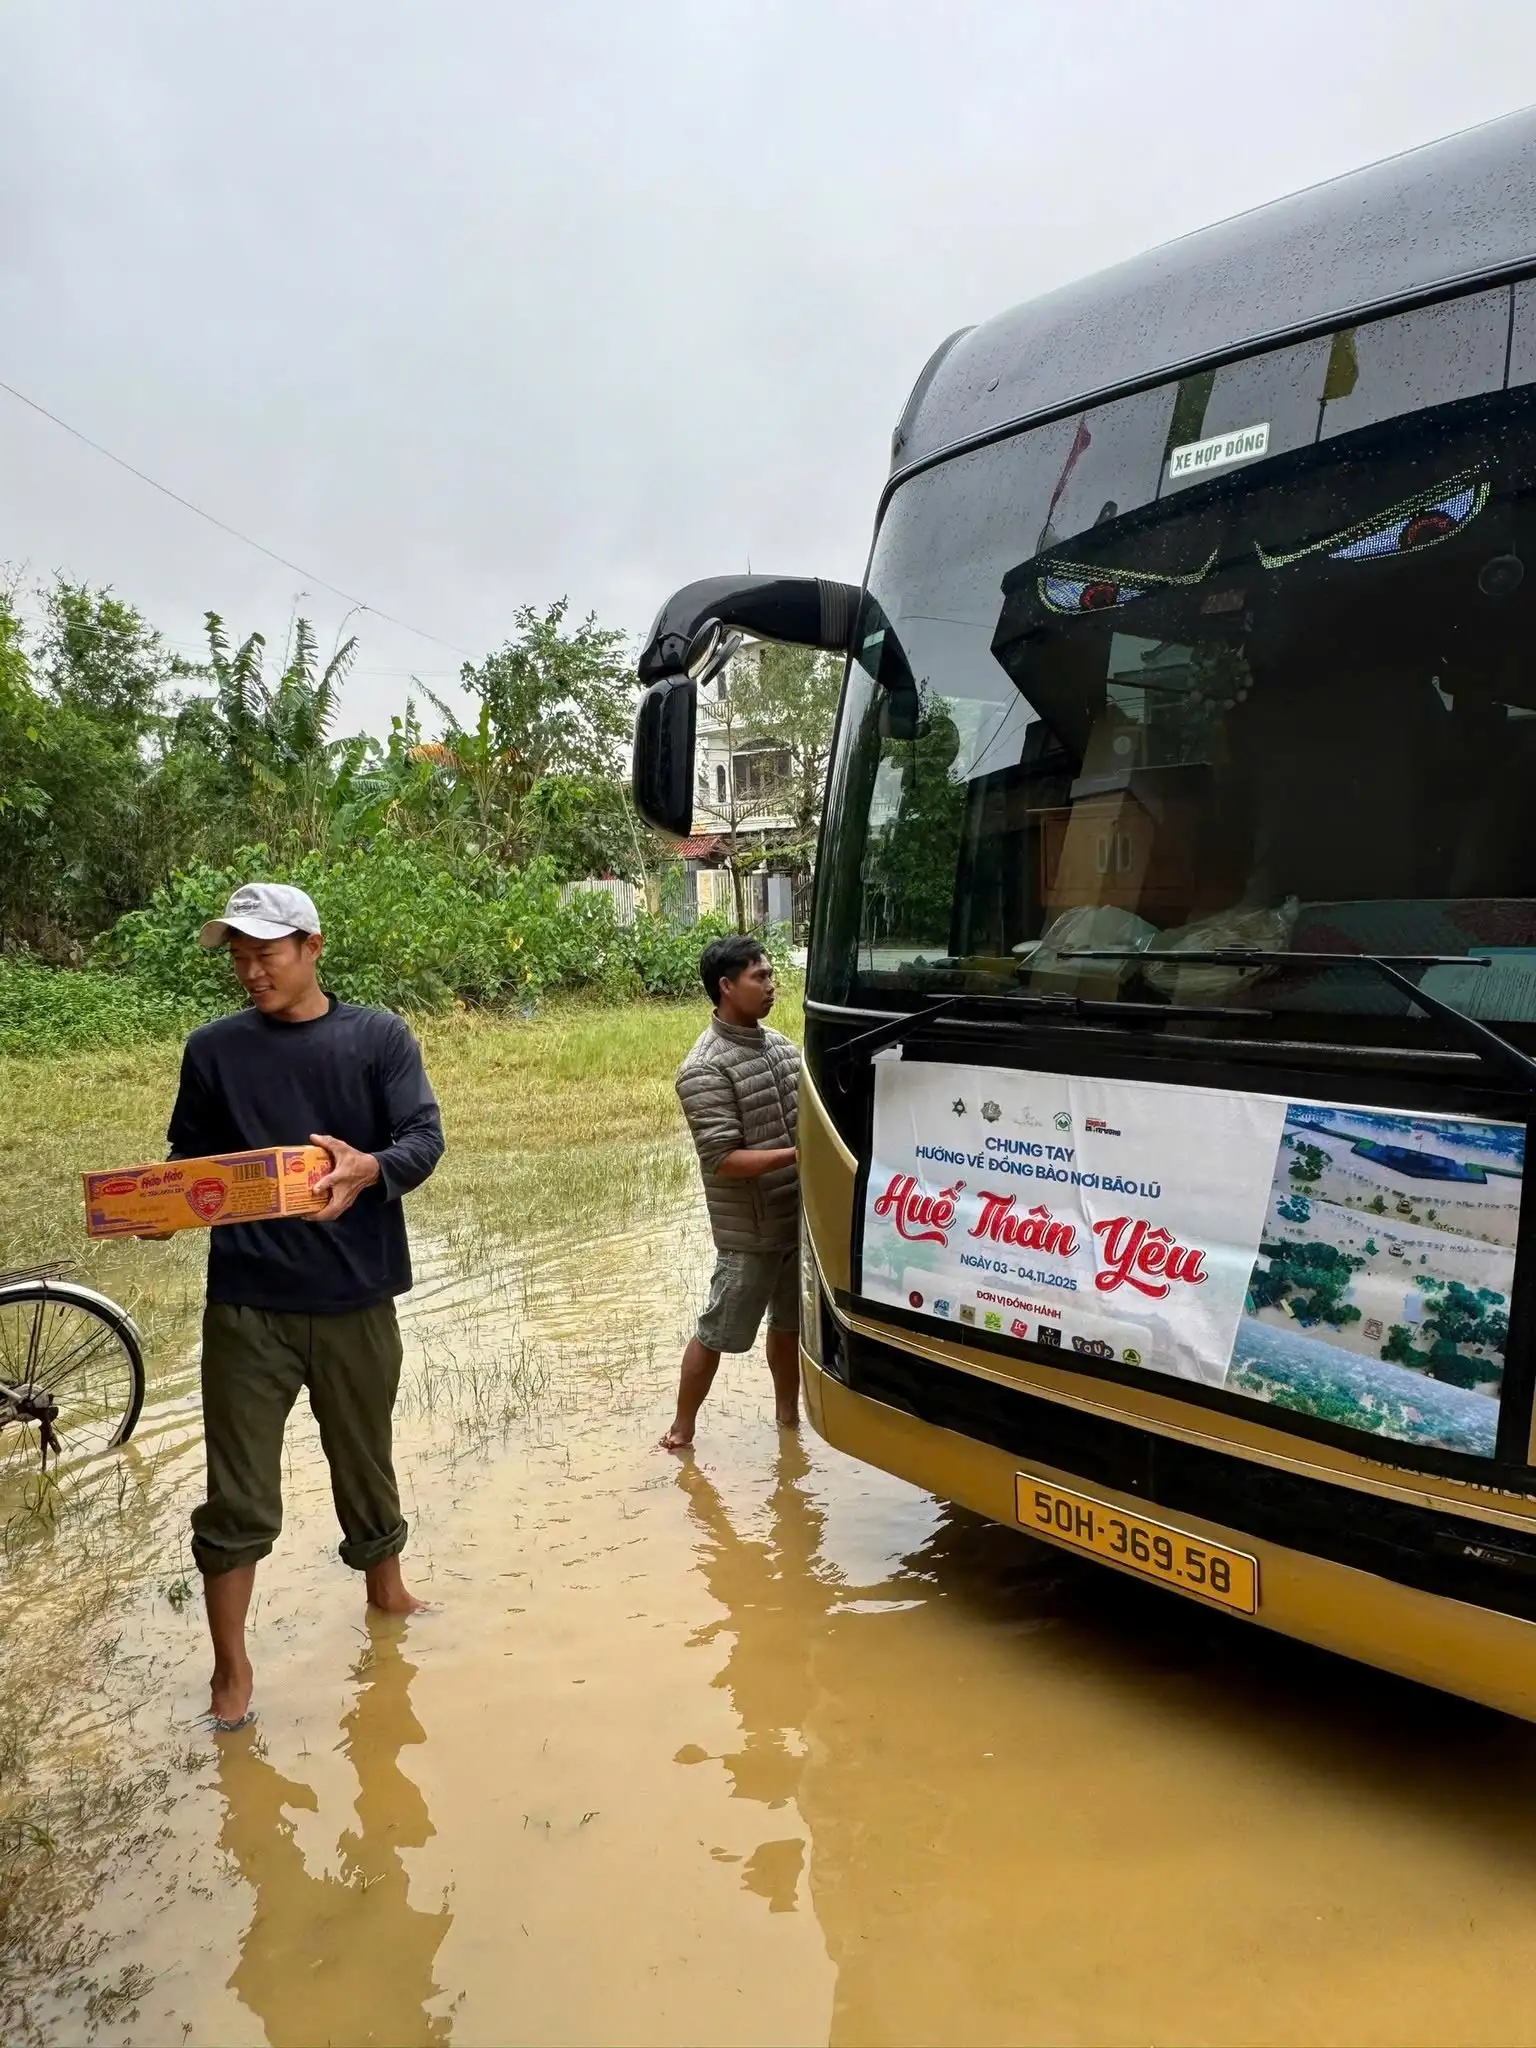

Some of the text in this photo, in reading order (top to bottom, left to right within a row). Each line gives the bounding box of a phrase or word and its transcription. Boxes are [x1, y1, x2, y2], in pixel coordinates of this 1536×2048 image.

[1174, 452, 1192, 471] XE
[1194, 444, 1222, 467] HỢP
[984, 1136, 1075, 1163] CHUNG TAY
[915, 1145, 965, 1165] HƯỚNG
[988, 1155, 1034, 1177] ĐỒNG
[1035, 1164, 1069, 1183] BÀO
[1070, 1171, 1100, 1189] NƠI
[1101, 1175, 1138, 1195] BÃO
[1139, 1181, 1161, 1199] LŨ
[873, 1173, 1209, 1300] Huế Thân Yêu
[960, 1253, 992, 1271] NGÀY
[993, 1260, 1008, 1275] 03
[1017, 1267, 1079, 1292] 04.11.2025
[976, 1290, 996, 1304] ĐƠN
[1034, 1490, 1231, 1594] 50H-369.58
